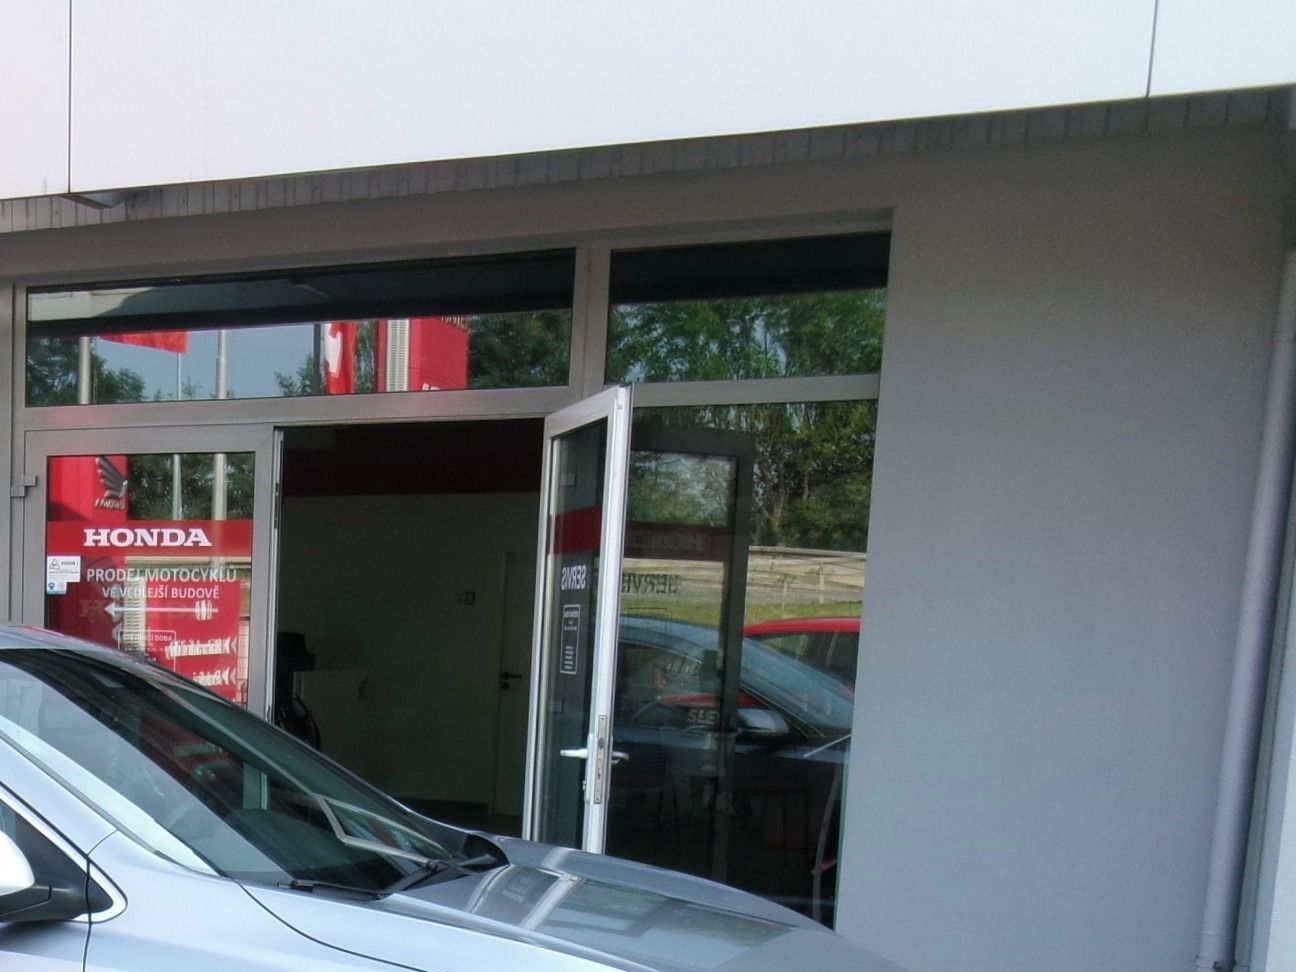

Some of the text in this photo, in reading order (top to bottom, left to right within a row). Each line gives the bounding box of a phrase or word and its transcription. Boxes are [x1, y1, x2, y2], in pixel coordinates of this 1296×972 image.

[84, 528, 212, 547] HONDA
[87, 568, 141, 583] PRODEJ
[102, 585, 219, 599] VE VEDLEJŠÍ BUDOVĚ
